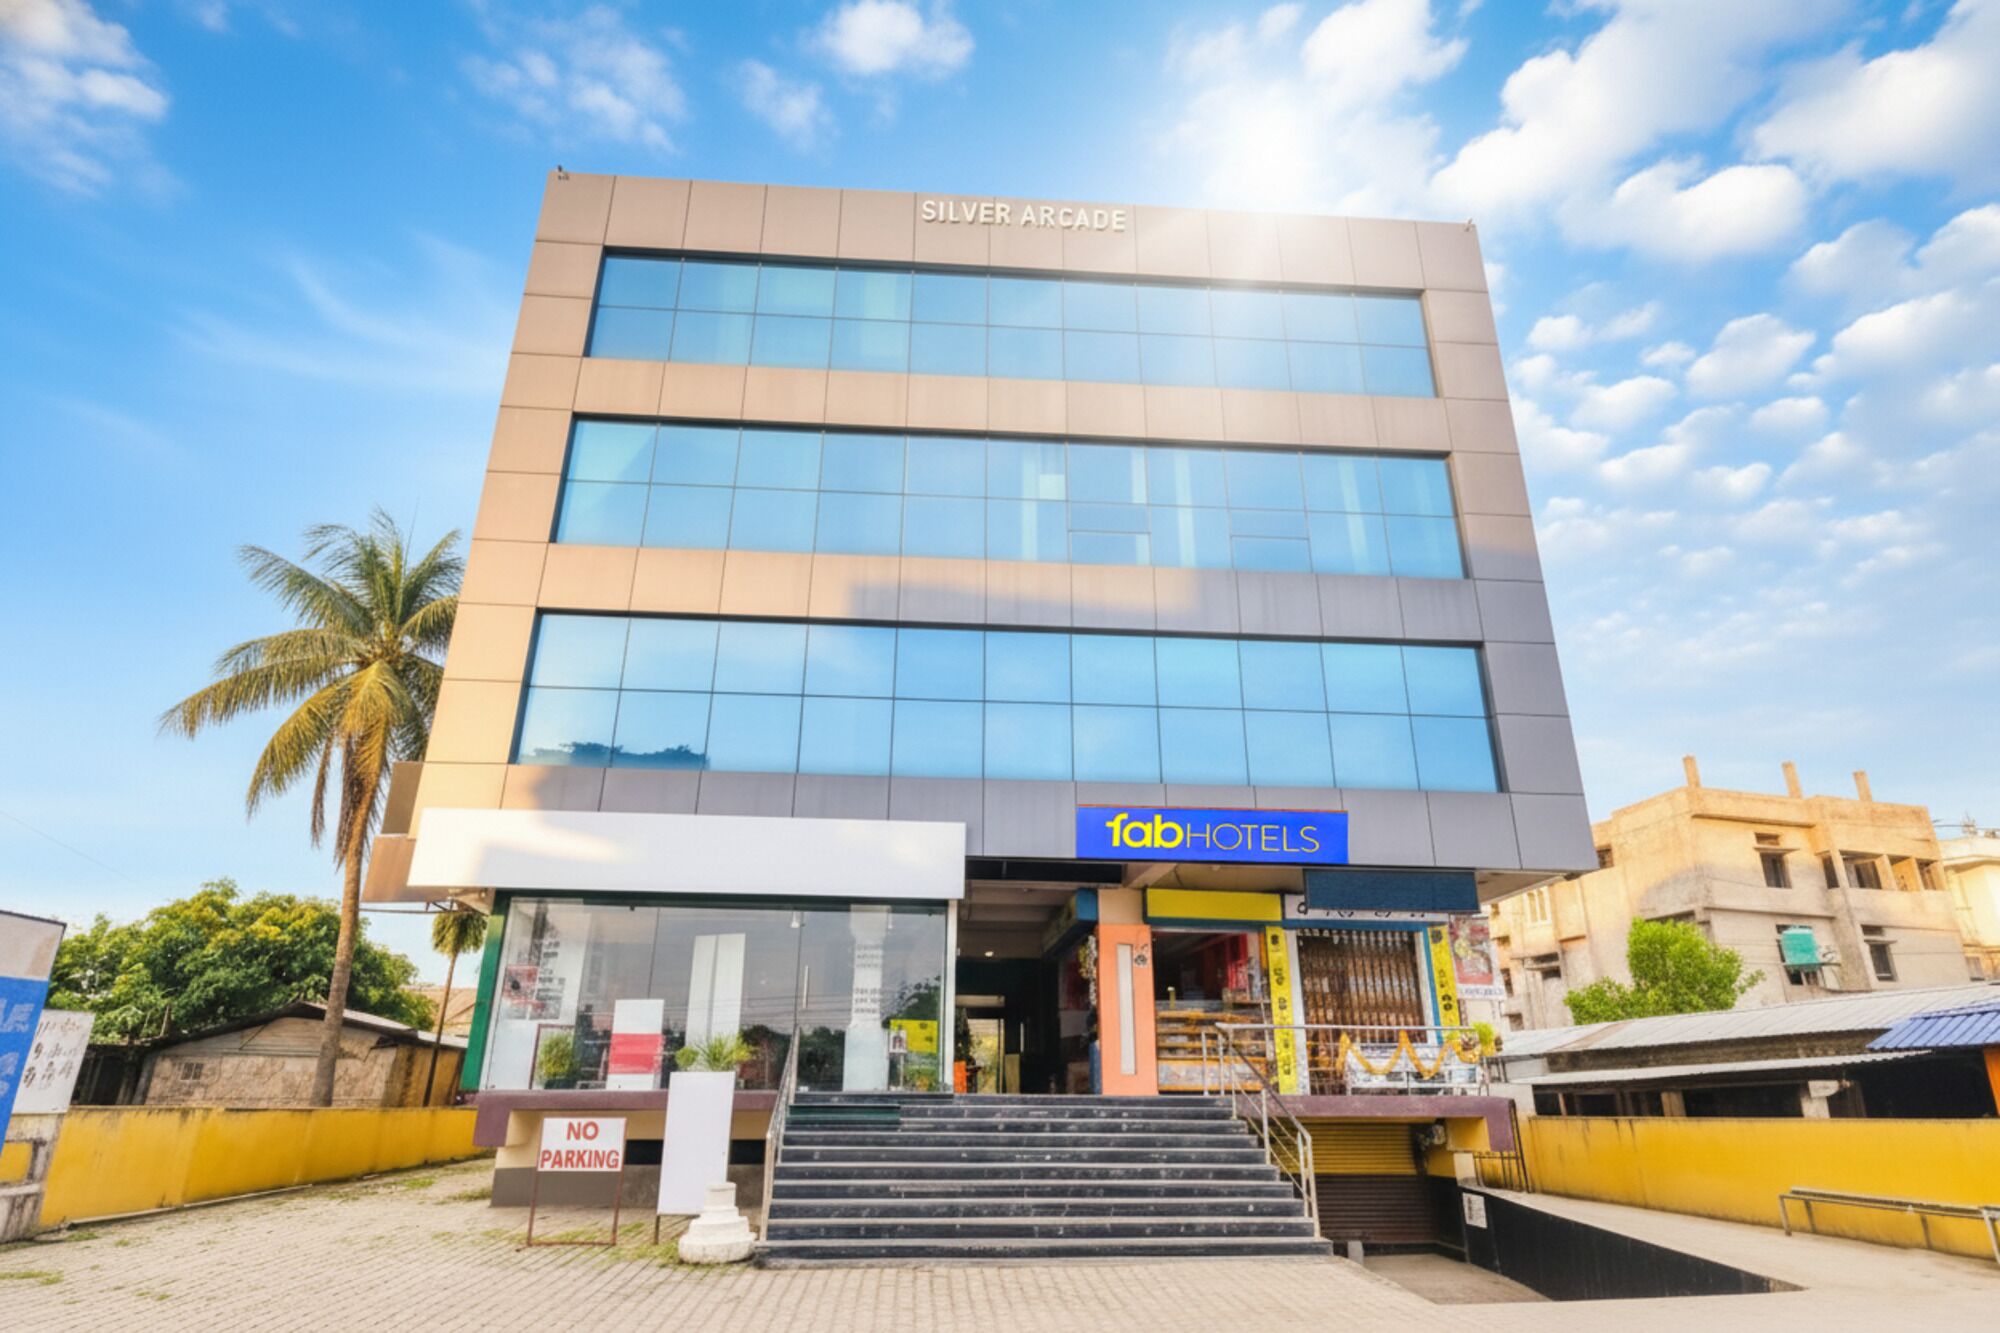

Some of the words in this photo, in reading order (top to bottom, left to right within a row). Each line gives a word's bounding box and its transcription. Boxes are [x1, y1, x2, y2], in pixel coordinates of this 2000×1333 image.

[921, 200, 1011, 225] SILVER
[1020, 205, 1127, 232] ARCADE
[566, 1121, 599, 1141] NO
[540, 1149, 620, 1169] PARKING
